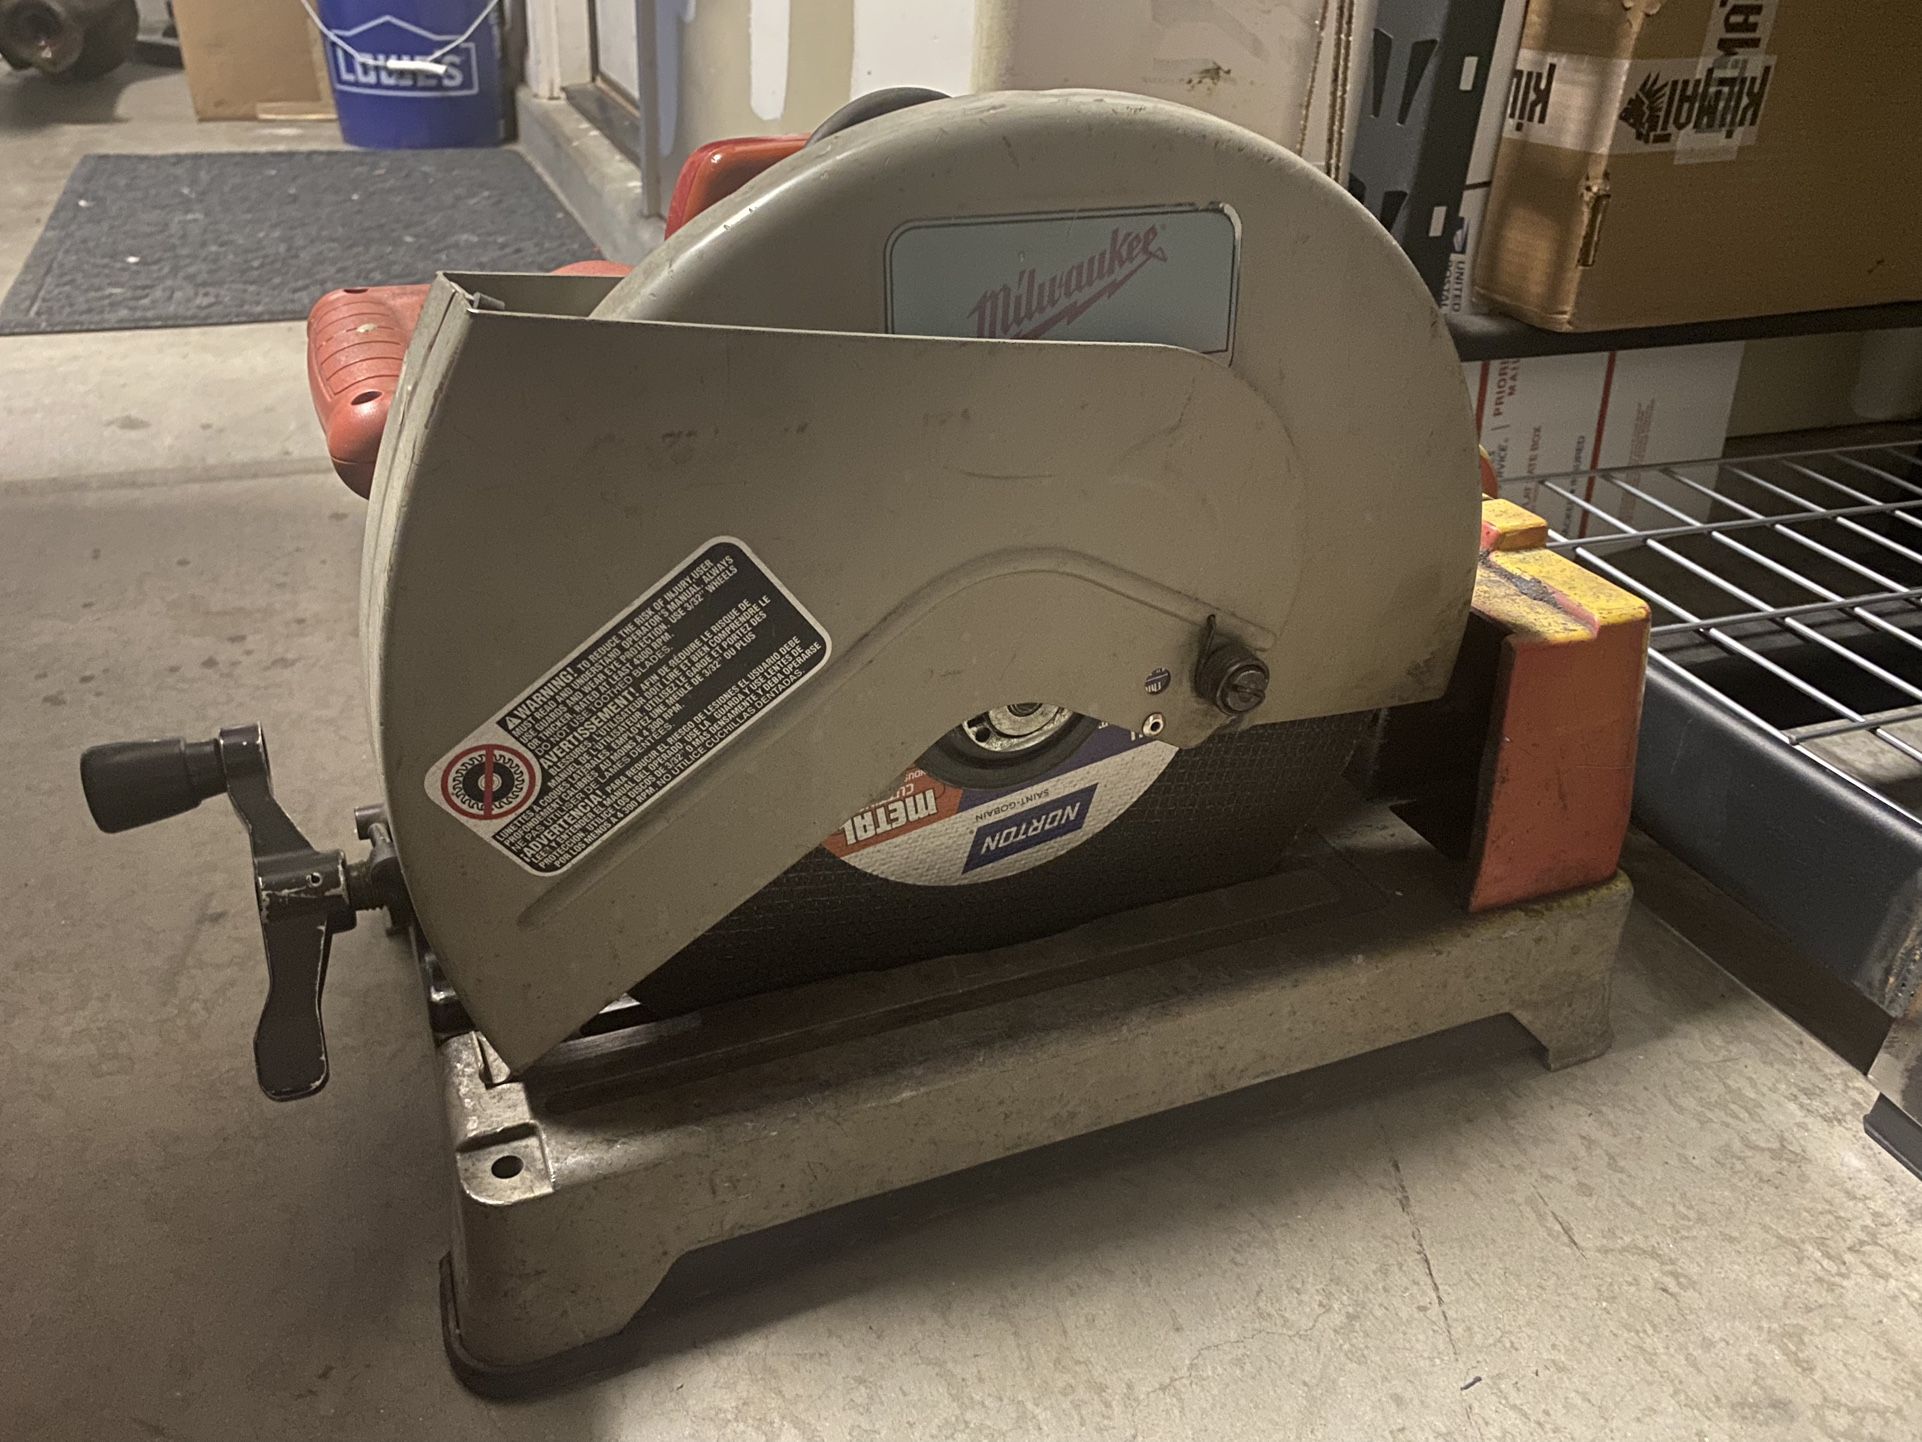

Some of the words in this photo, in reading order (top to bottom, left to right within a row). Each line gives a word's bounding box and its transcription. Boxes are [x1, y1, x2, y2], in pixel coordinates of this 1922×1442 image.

[967, 223, 1159, 339] Milwaukee
[1452, 260, 1466, 313] UNITED
[839, 788, 938, 847] METAL
[981, 802, 1081, 855] NORTON
